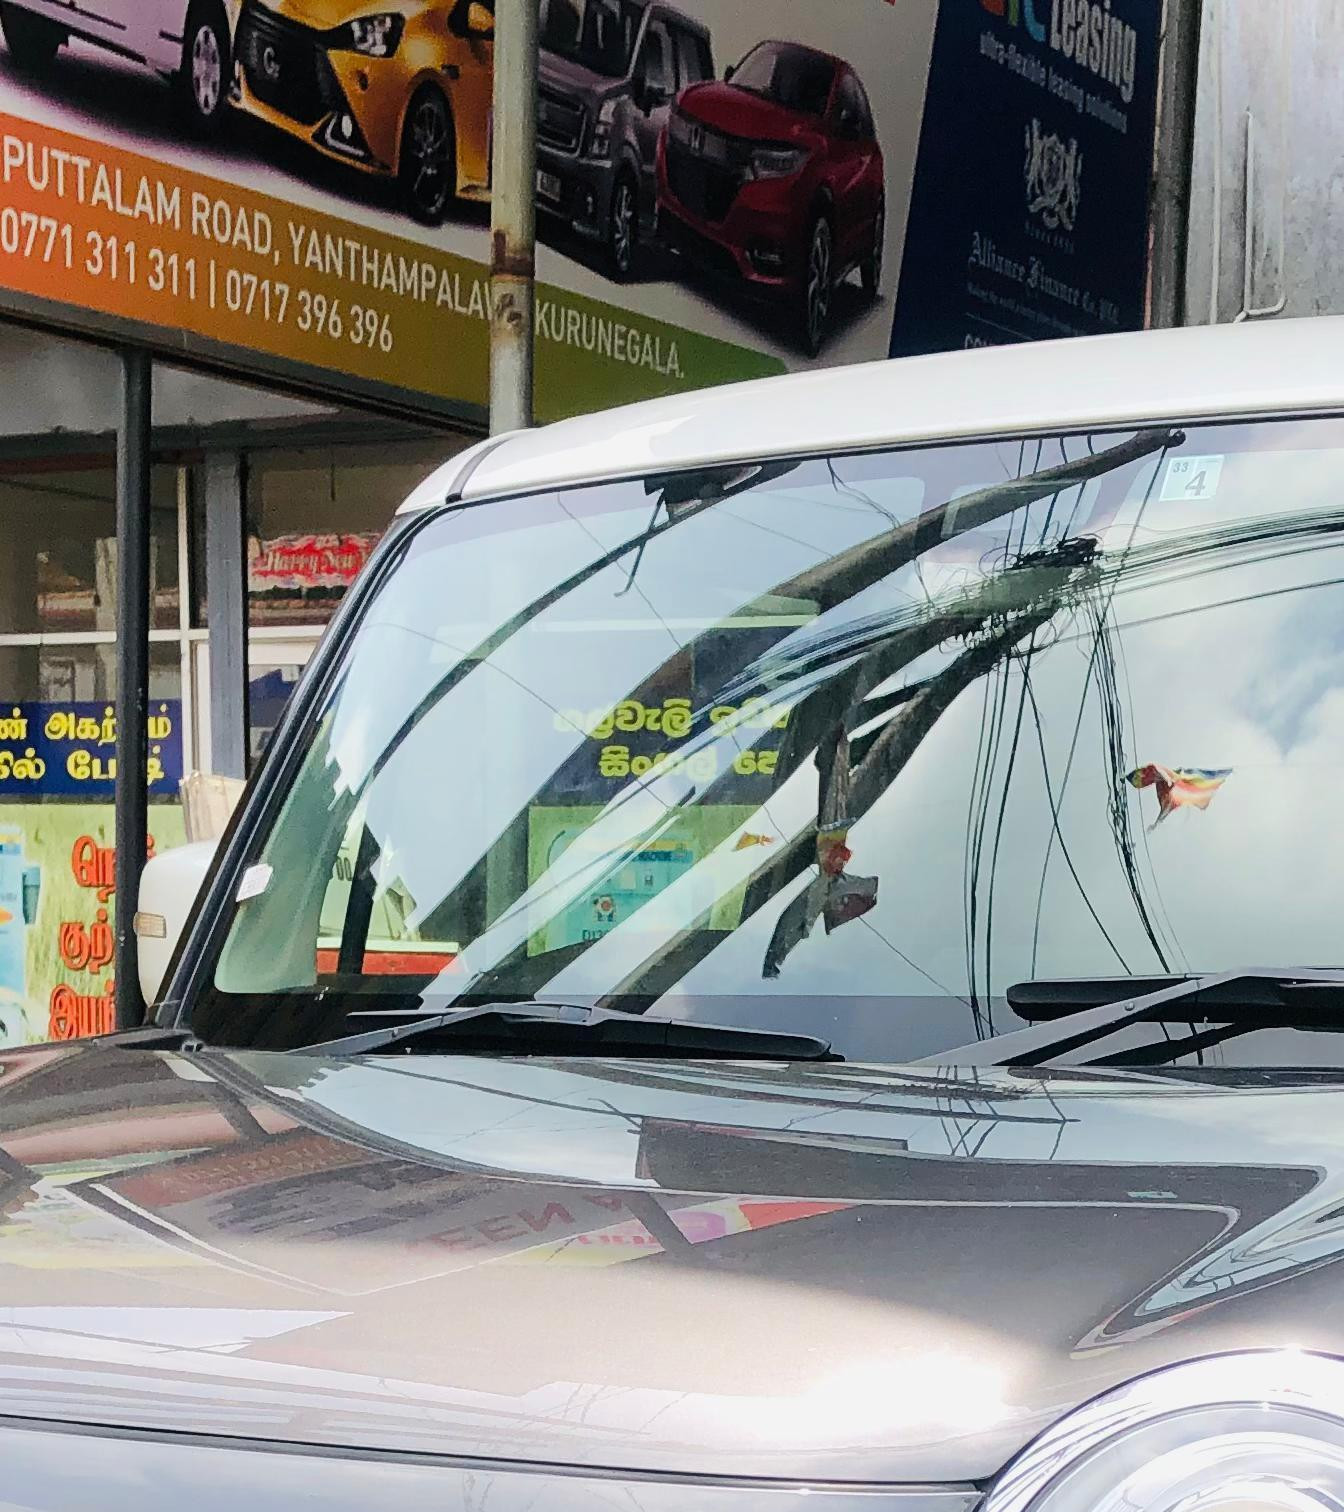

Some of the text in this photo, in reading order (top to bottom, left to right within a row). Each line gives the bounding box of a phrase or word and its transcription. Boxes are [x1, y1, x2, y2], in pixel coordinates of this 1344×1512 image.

[0, 206, 73, 270] 0771
[85, 230, 136, 285] 311
[147, 248, 196, 300] 311
[225, 268, 290, 324] 0717
[296, 290, 343, 340] 396
[349, 304, 393, 353] 396
[3, 134, 181, 230] PUTTALAM
[191, 191, 280, 266] ROAD,
[535, 299, 684, 379] KURUNEGALA.
[1185, 471, 1207, 497] 4
